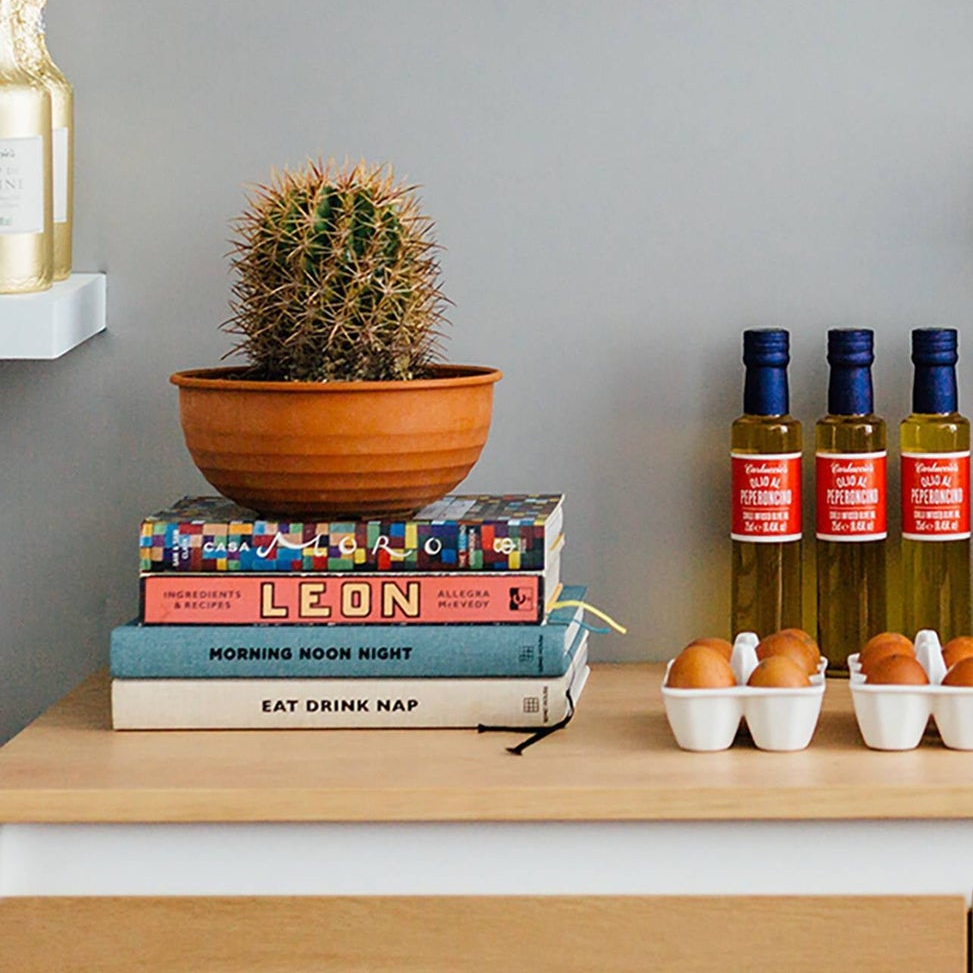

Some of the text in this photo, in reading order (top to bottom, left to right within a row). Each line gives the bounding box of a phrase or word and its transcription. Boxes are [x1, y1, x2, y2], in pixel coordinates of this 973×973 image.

[203, 531, 442, 557] CASA MORO
[163, 590, 242, 599] INGREDIENTS
[260, 581, 421, 619] LEON
[438, 590, 490, 598] ALLEGRA
[174, 601, 231, 609] & RECIPES
[209, 647, 413, 661] MORNING NOON NIGHT
[261, 699, 419, 713] EAT DRINK NAP
